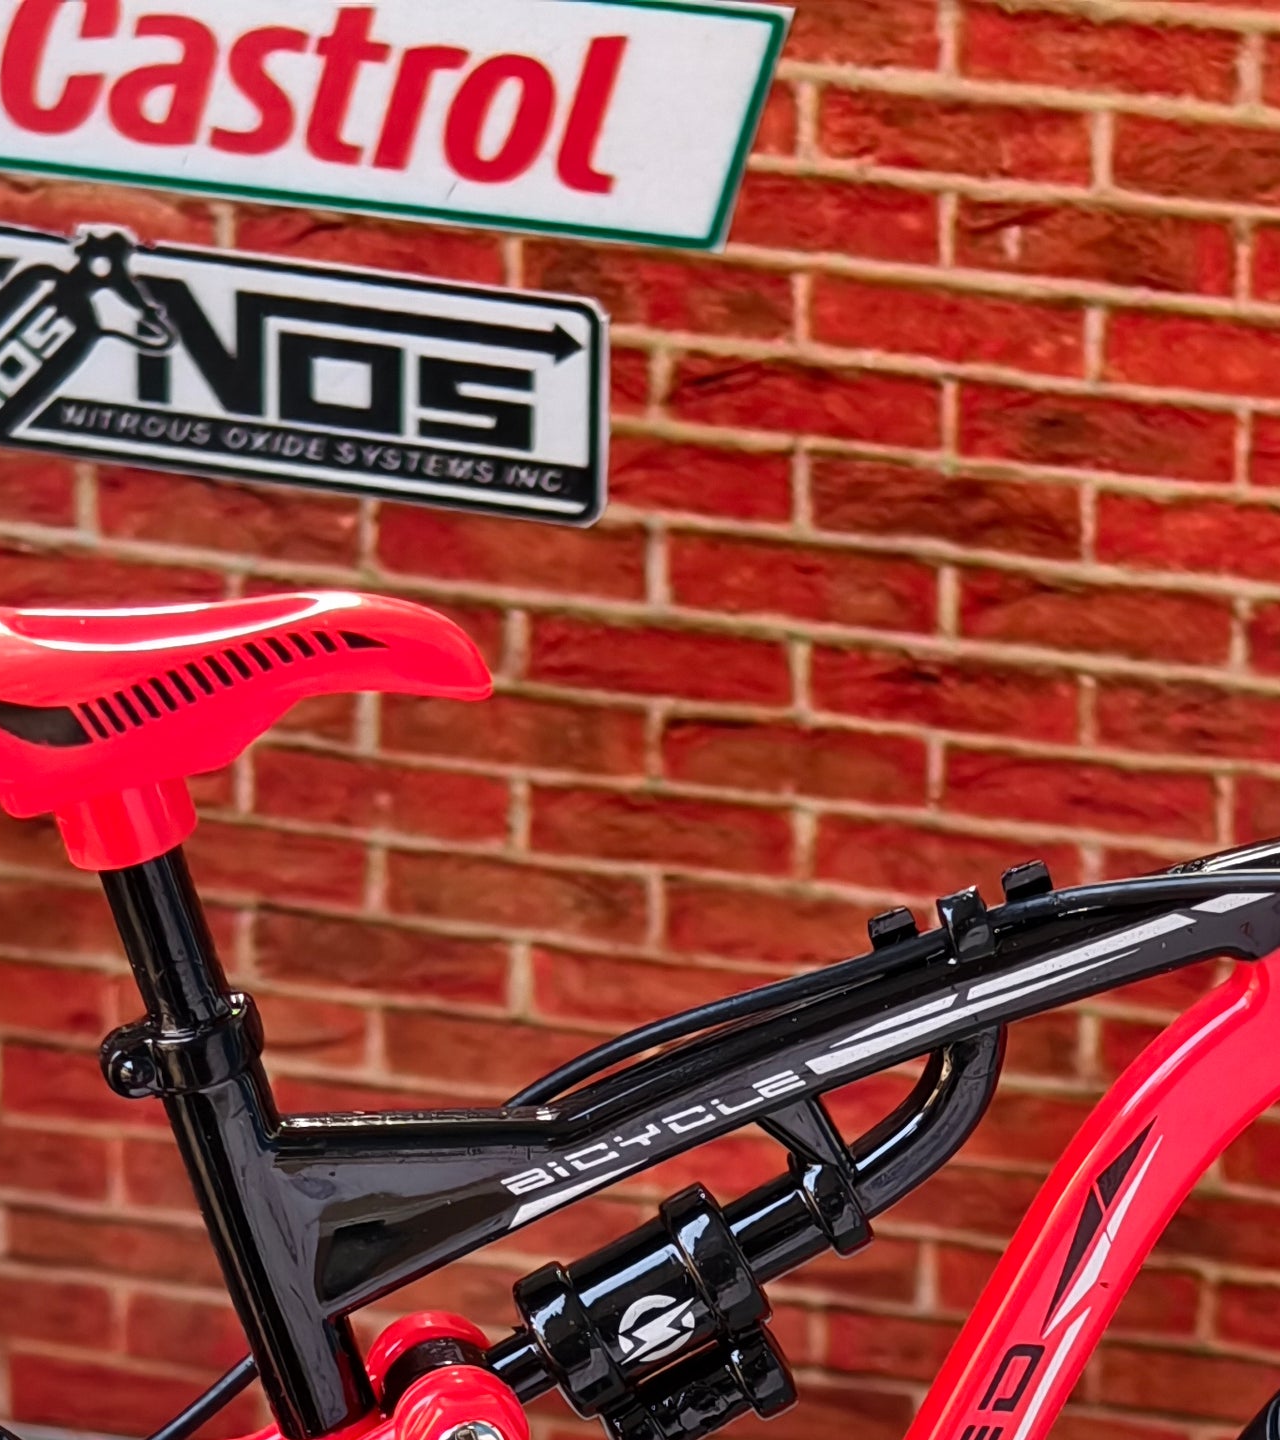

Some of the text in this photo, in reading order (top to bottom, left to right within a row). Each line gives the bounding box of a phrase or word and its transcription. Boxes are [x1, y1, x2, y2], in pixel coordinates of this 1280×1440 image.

[137, 274, 536, 452] NOS
[60, 405, 211, 446] NITROUS
[225, 426, 325, 462] OXIDE
[332, 443, 494, 485] SYSTEMS
